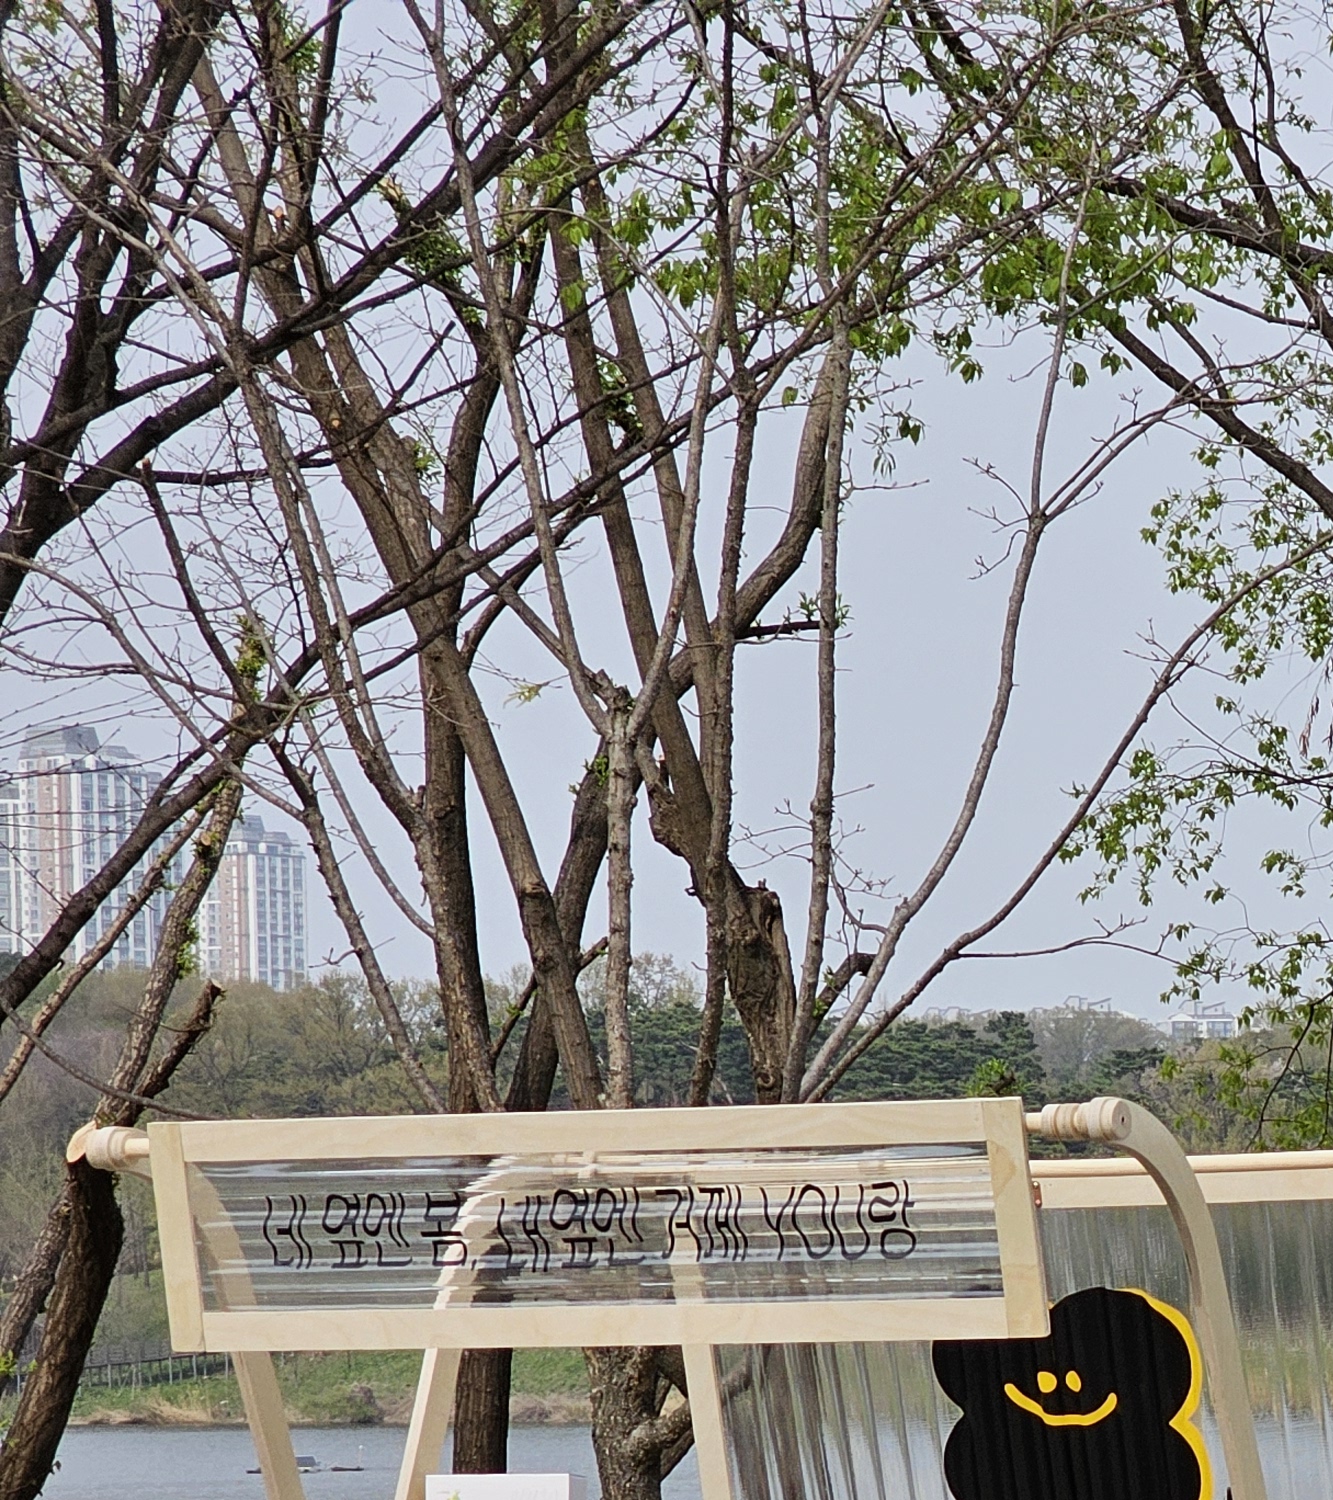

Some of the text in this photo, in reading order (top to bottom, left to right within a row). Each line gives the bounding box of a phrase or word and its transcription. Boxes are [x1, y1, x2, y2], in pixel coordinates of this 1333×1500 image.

[263, 1195, 313, 1268] 네
[322, 1193, 412, 1269] 옆엔
[654, 1184, 749, 1263] 거제
[759, 1180, 917, 1262] YOU랑
